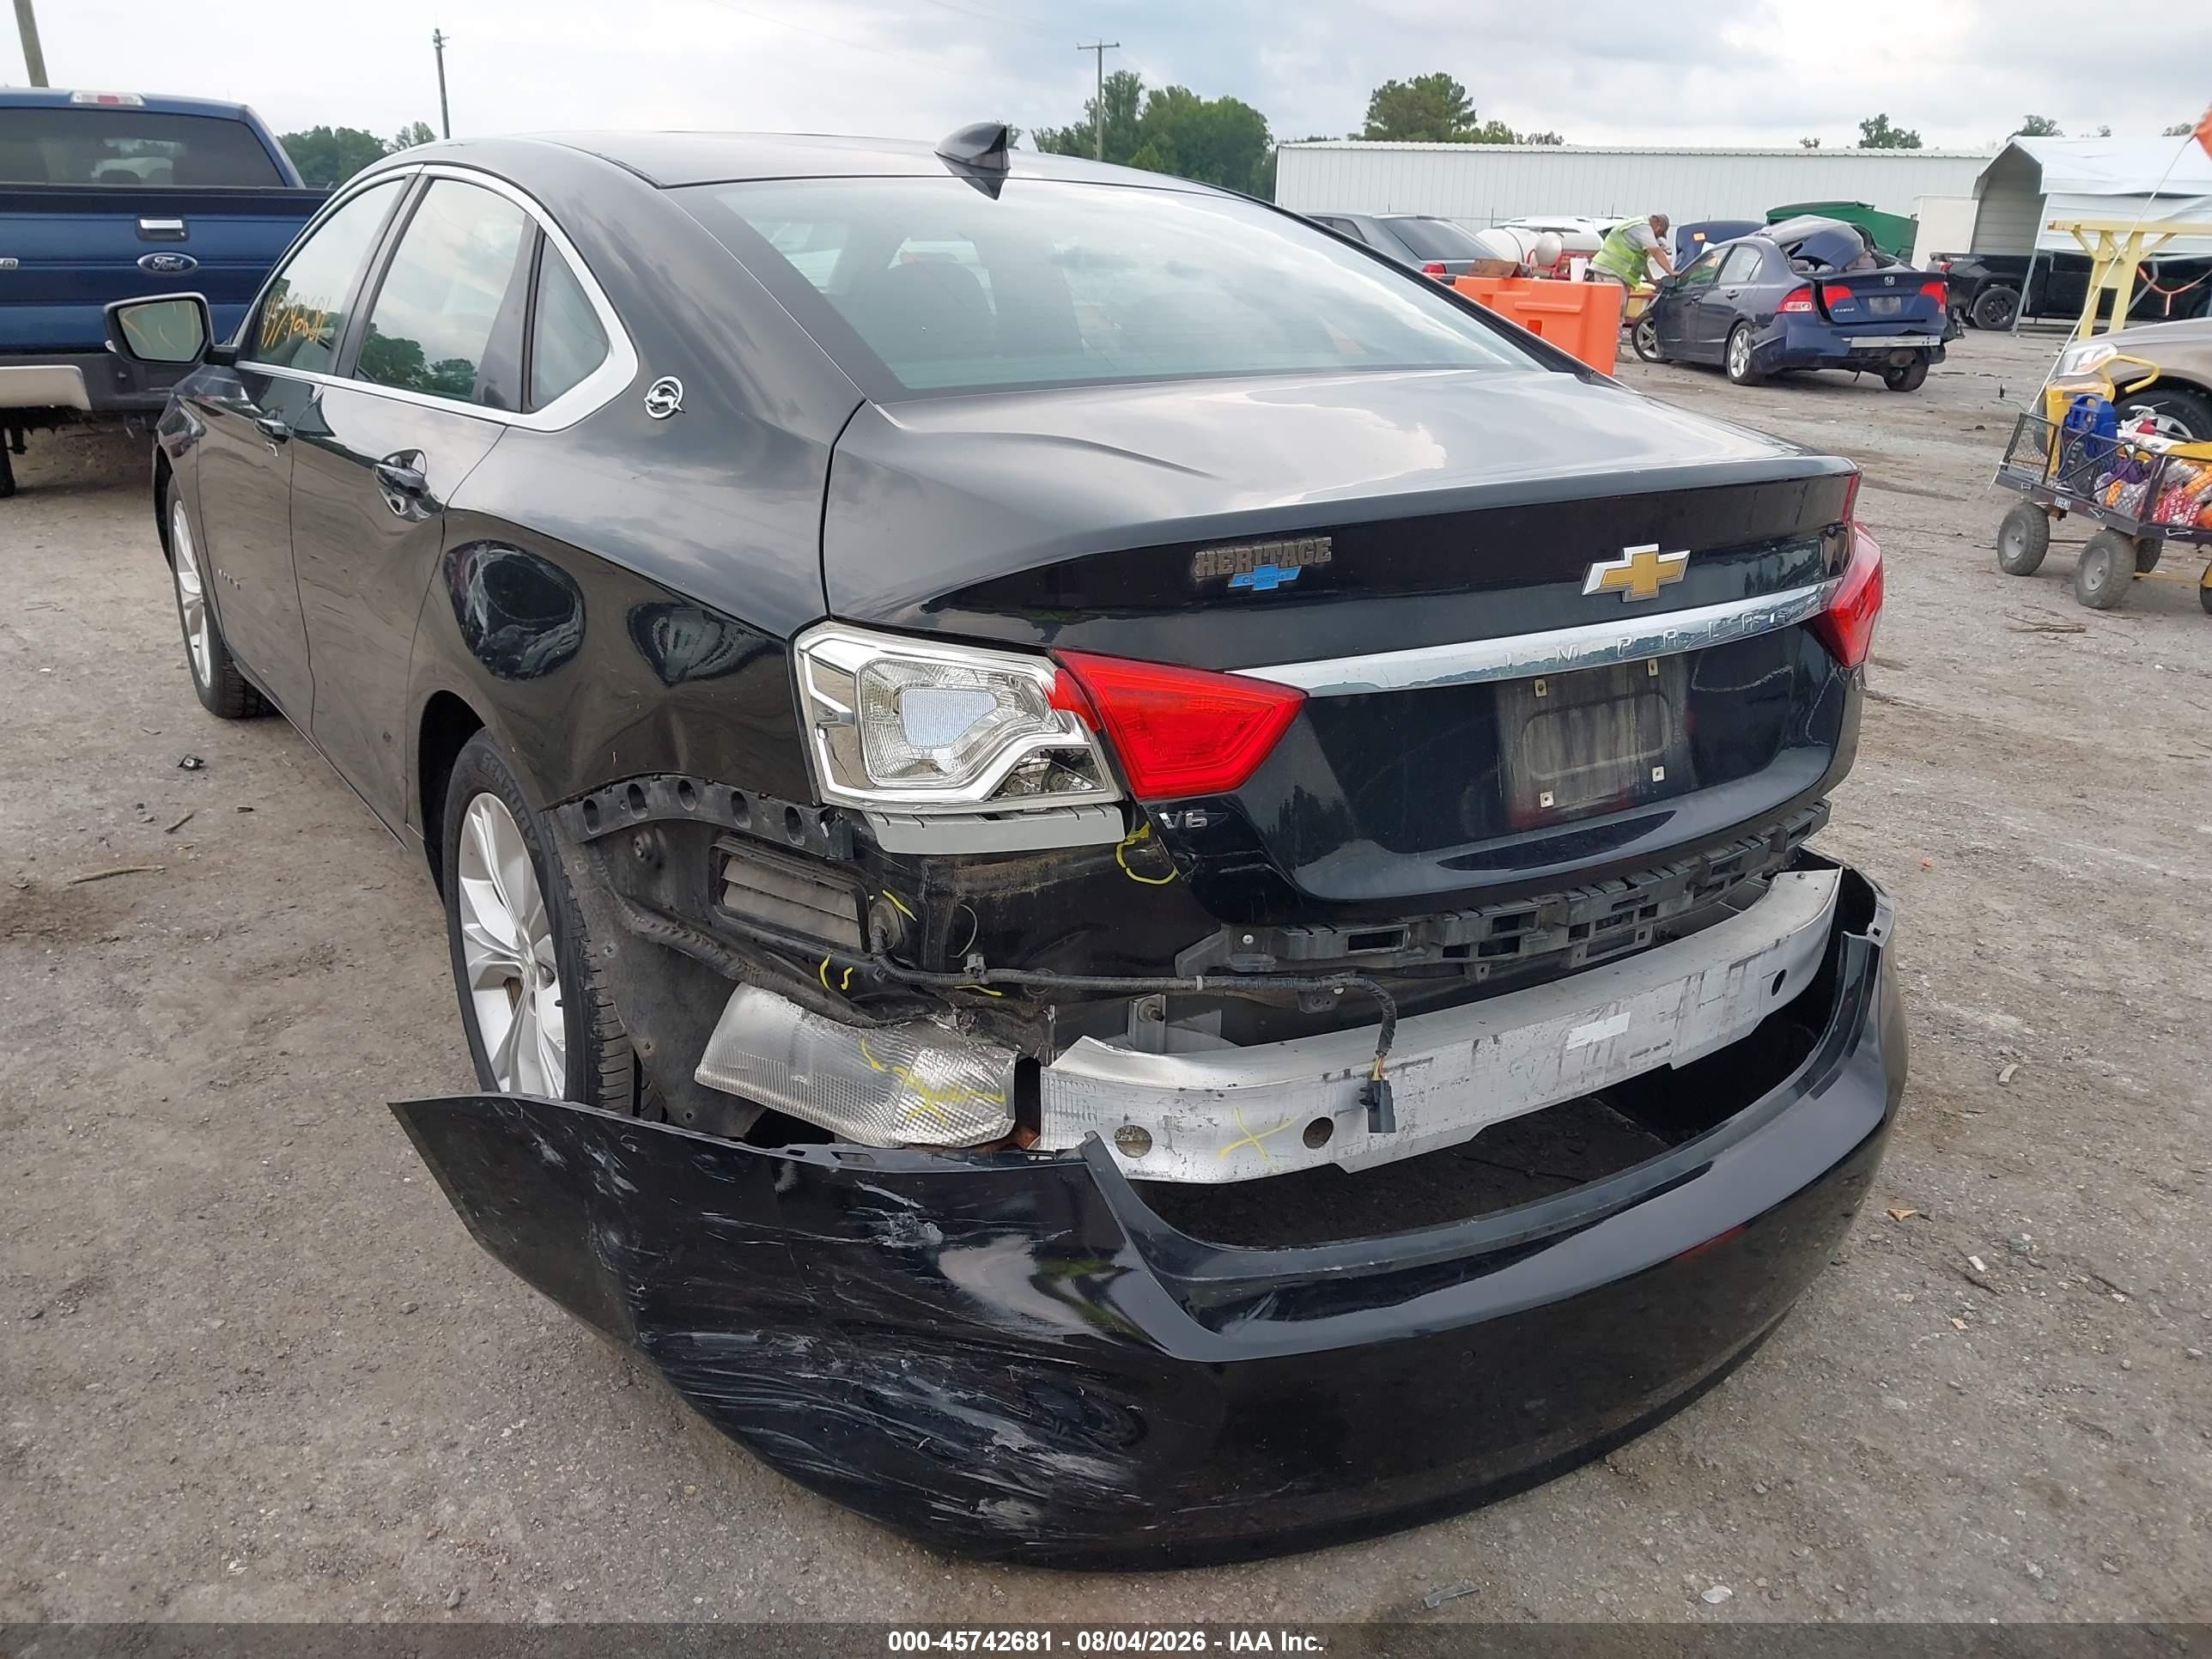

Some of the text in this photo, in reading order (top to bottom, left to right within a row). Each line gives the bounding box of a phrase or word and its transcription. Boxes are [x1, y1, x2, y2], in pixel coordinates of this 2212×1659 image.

[152, 255, 185, 270] Ford
[1194, 537, 1332, 577] HERITAGE
[1504, 611, 1753, 669] IMPALA
[1159, 810, 1207, 830] V6
